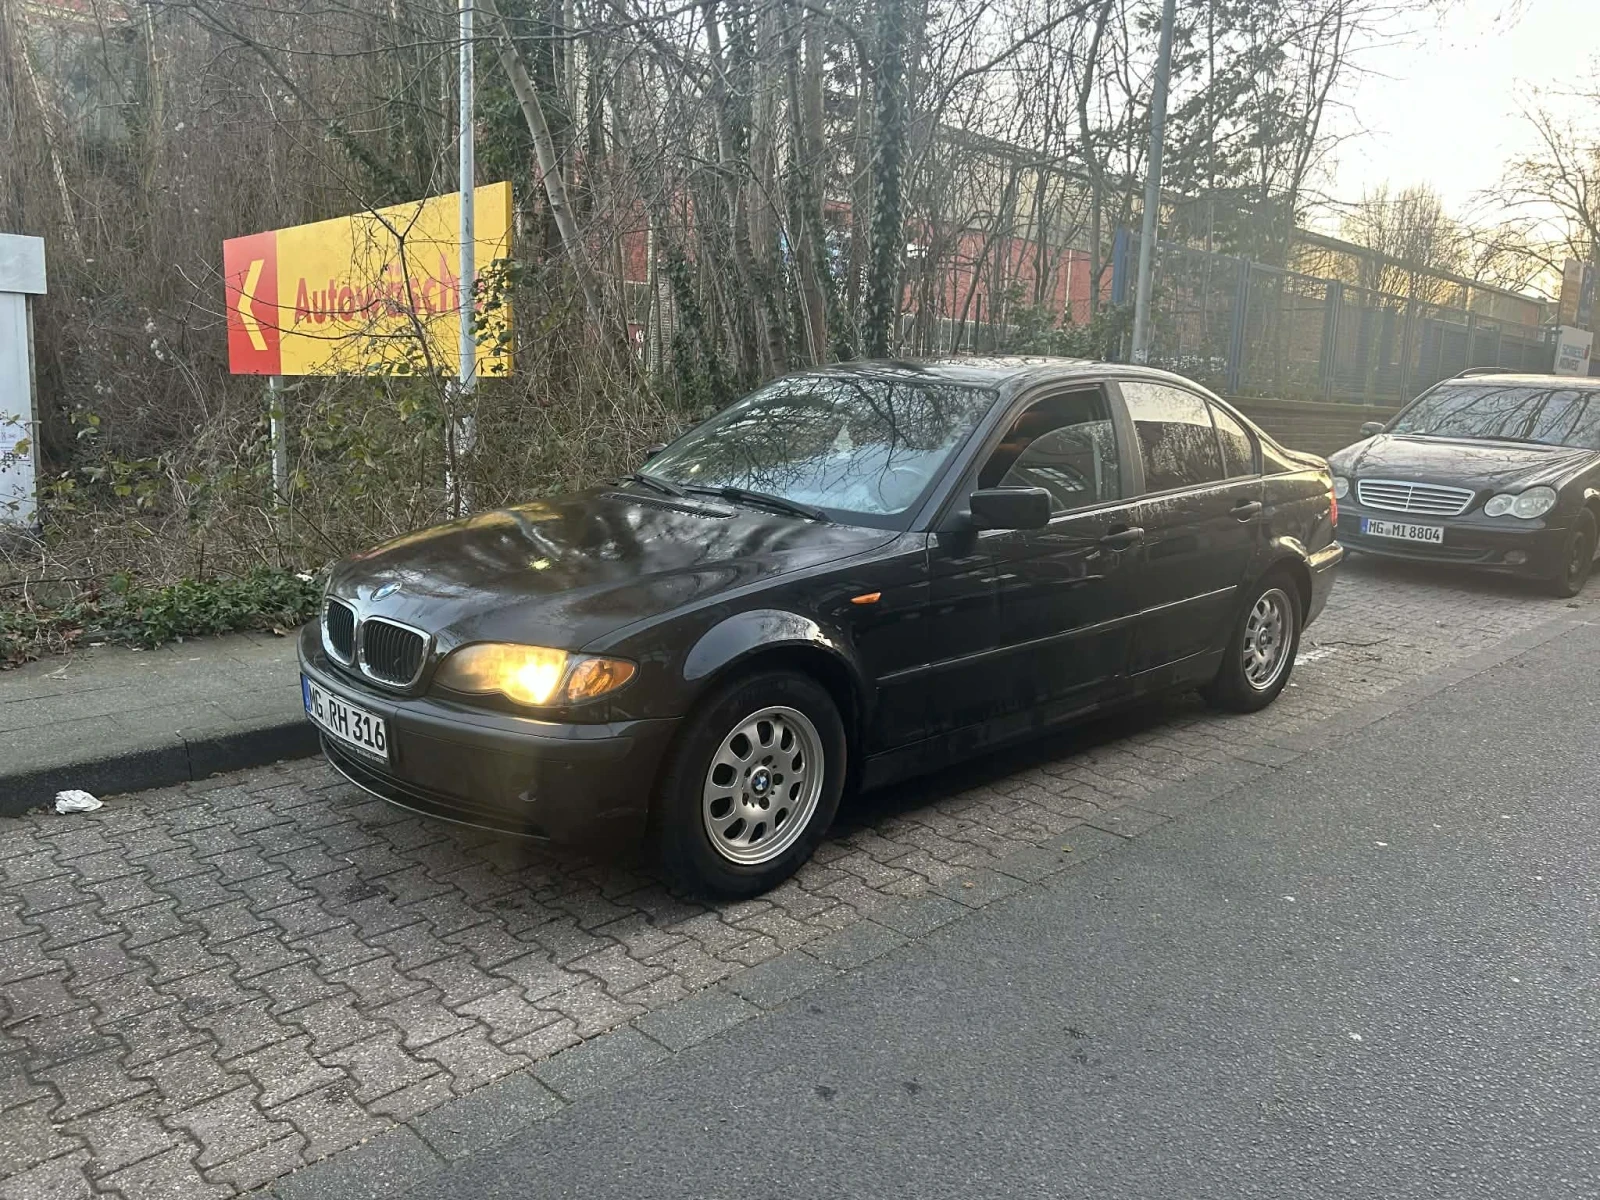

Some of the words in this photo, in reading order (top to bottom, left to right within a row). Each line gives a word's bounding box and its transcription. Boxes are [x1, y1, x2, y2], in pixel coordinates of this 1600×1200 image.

[1368, 520, 1385, 535] MG
[1392, 524, 1407, 538] MI
[1409, 526, 1440, 542] 8804
[309, 685, 324, 720] MG
[328, 699, 349, 737] RH
[352, 710, 386, 751] 316
